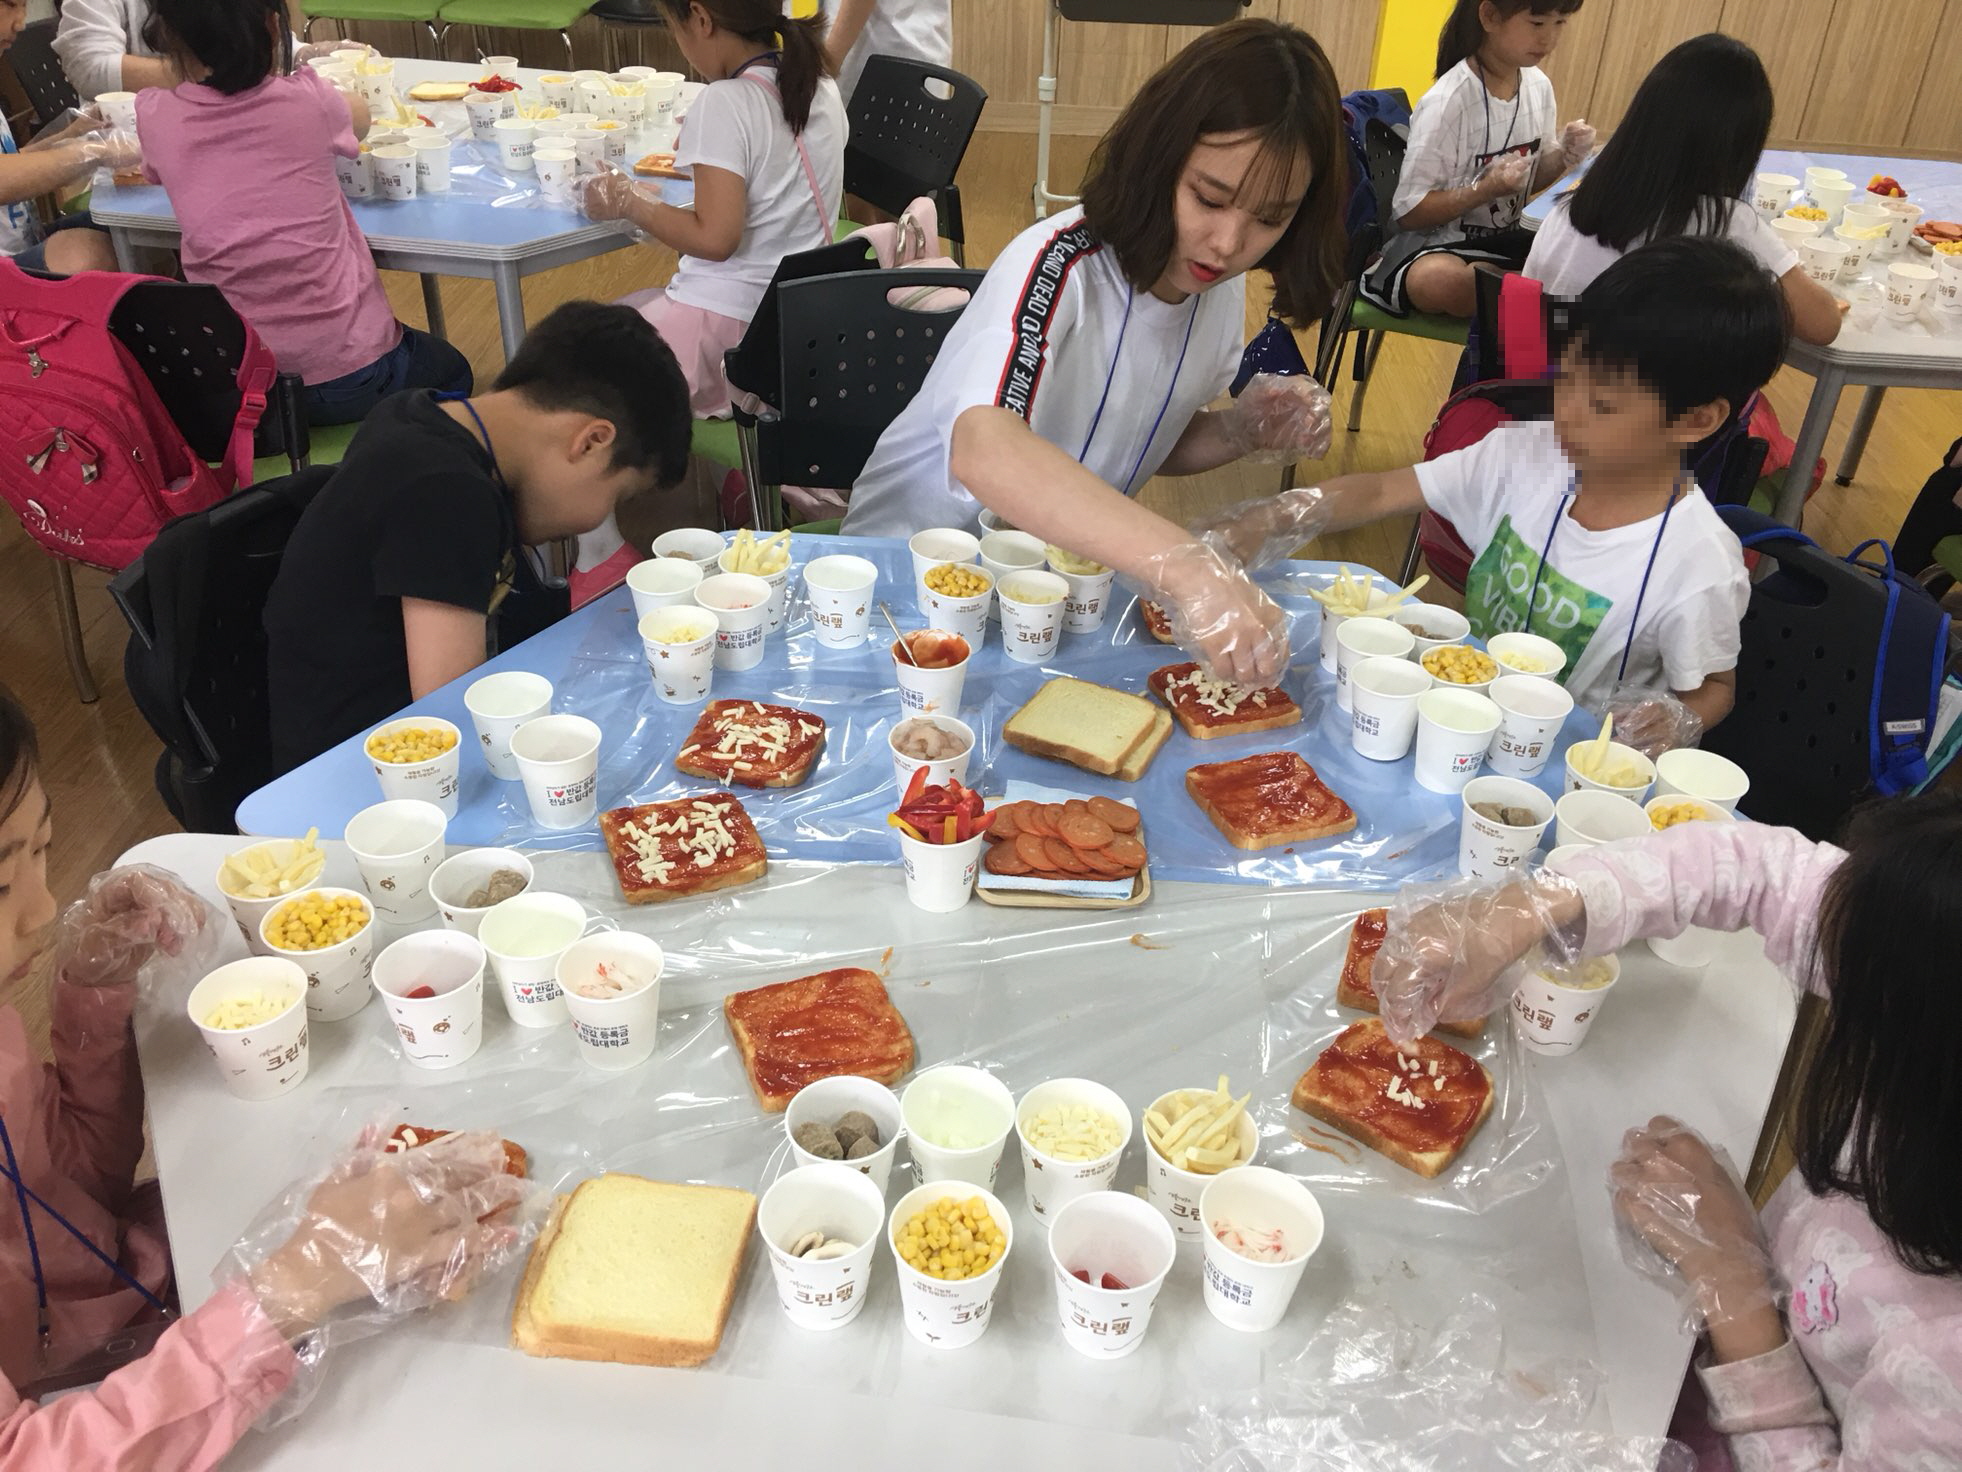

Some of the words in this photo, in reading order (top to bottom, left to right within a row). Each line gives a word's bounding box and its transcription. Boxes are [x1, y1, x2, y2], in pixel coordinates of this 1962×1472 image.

[1028, 275, 1056, 316] DEAD
[1065, 598, 1099, 615] 크린랲
[813, 612, 843, 629] 크린랲
[730, 633, 745, 641] 반값
[1016, 626, 1054, 644] 크린랲
[1499, 740, 1543, 758] 크린랲
[566, 784, 582, 796] 반값
[534, 983, 554, 994] 반값
[580, 1026, 598, 1039] 반값
[600, 1028, 629, 1039] 등록금
[1169, 1203, 1201, 1221] 크린
[793, 1280, 855, 1307] 크린랲
[1222, 1278, 1253, 1298] 등록금
[951, 1299, 991, 1325] 크린
[1070, 1311, 1133, 1336] 크린랲
